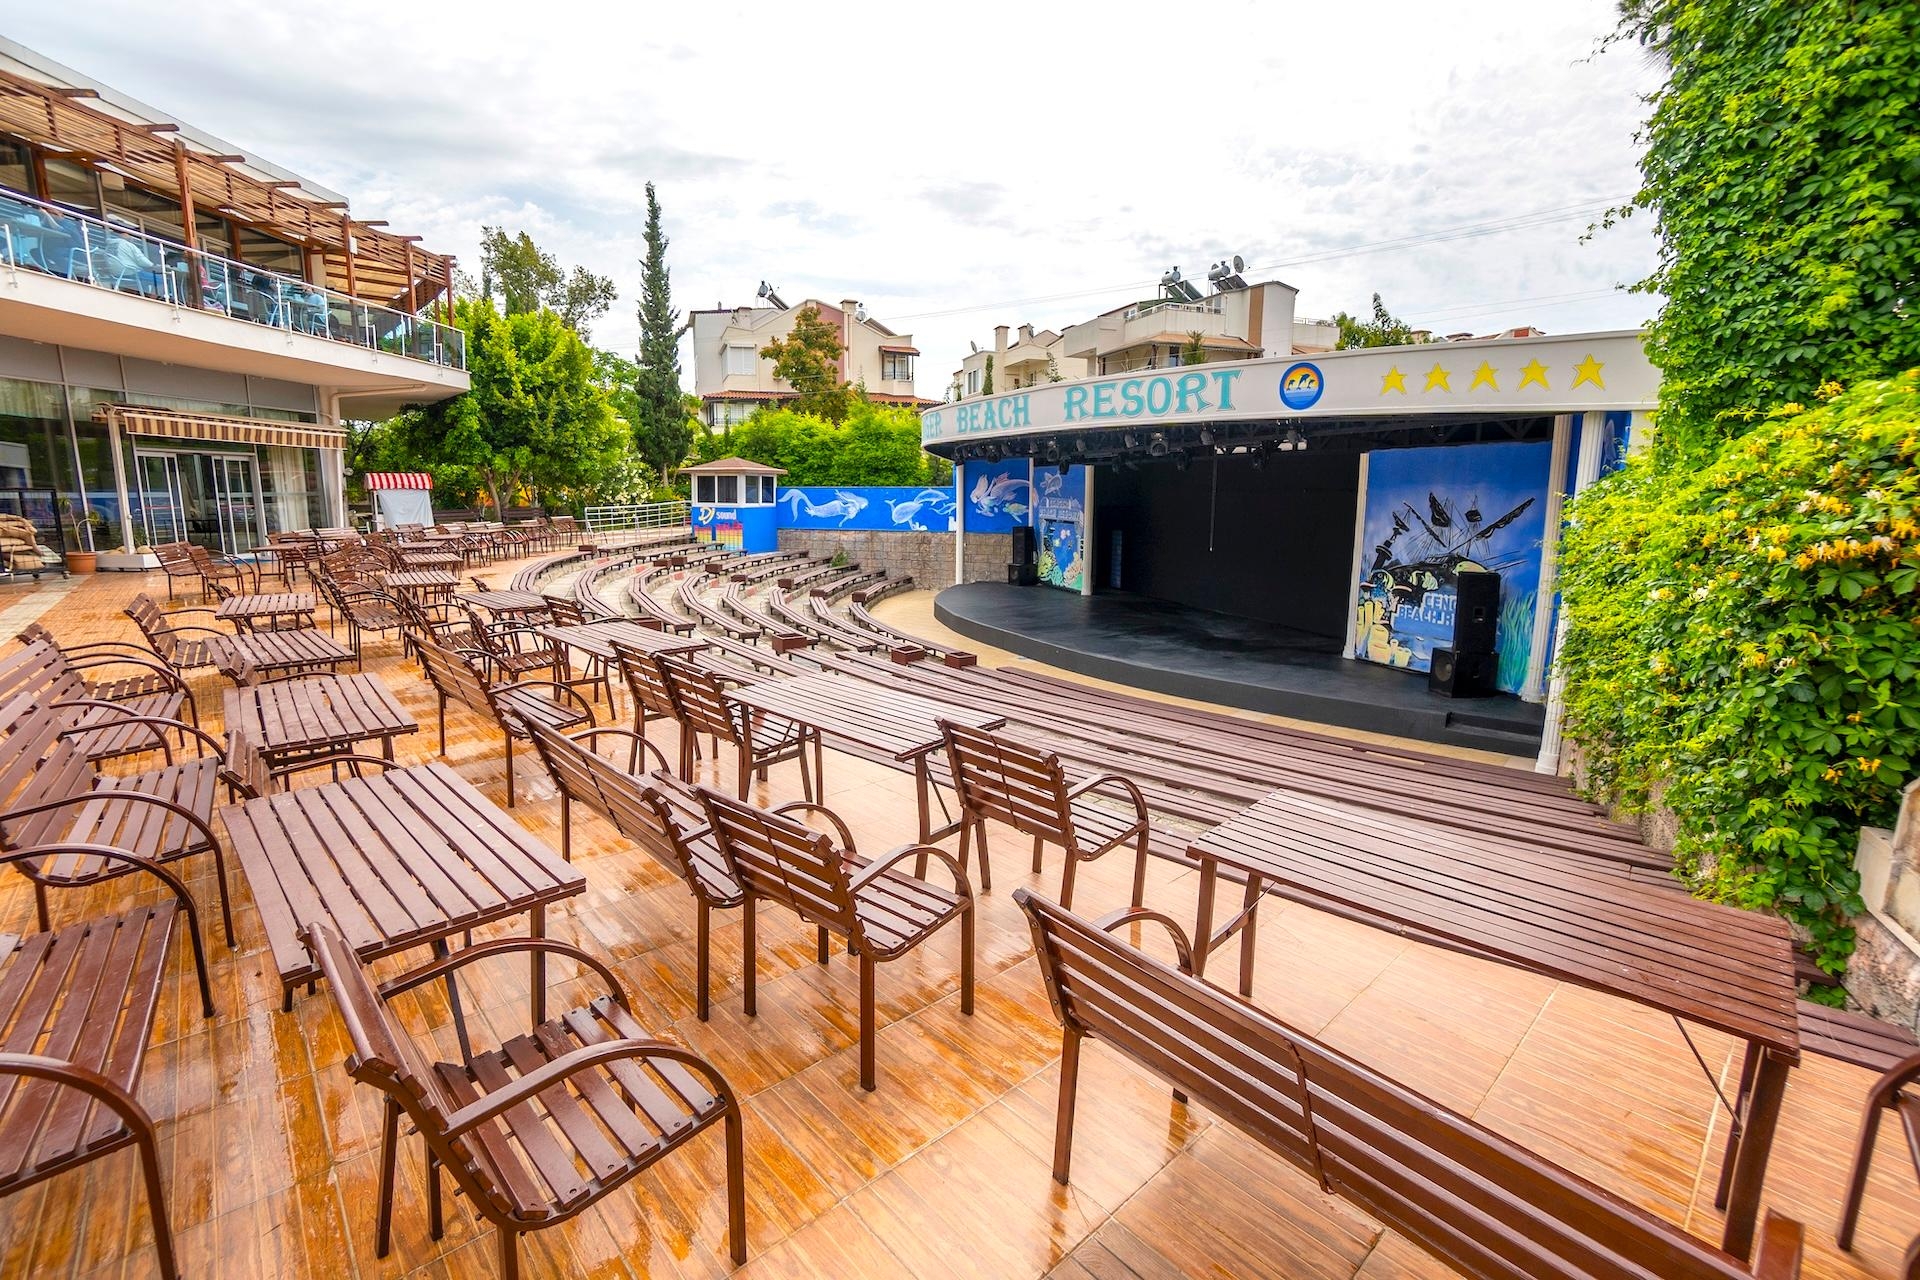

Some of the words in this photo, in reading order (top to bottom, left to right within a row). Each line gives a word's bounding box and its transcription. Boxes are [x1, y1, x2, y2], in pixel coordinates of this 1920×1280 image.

[957, 395, 1031, 434] BEACH
[1065, 370, 1243, 421] RESORT
[716, 509, 737, 520] sound
